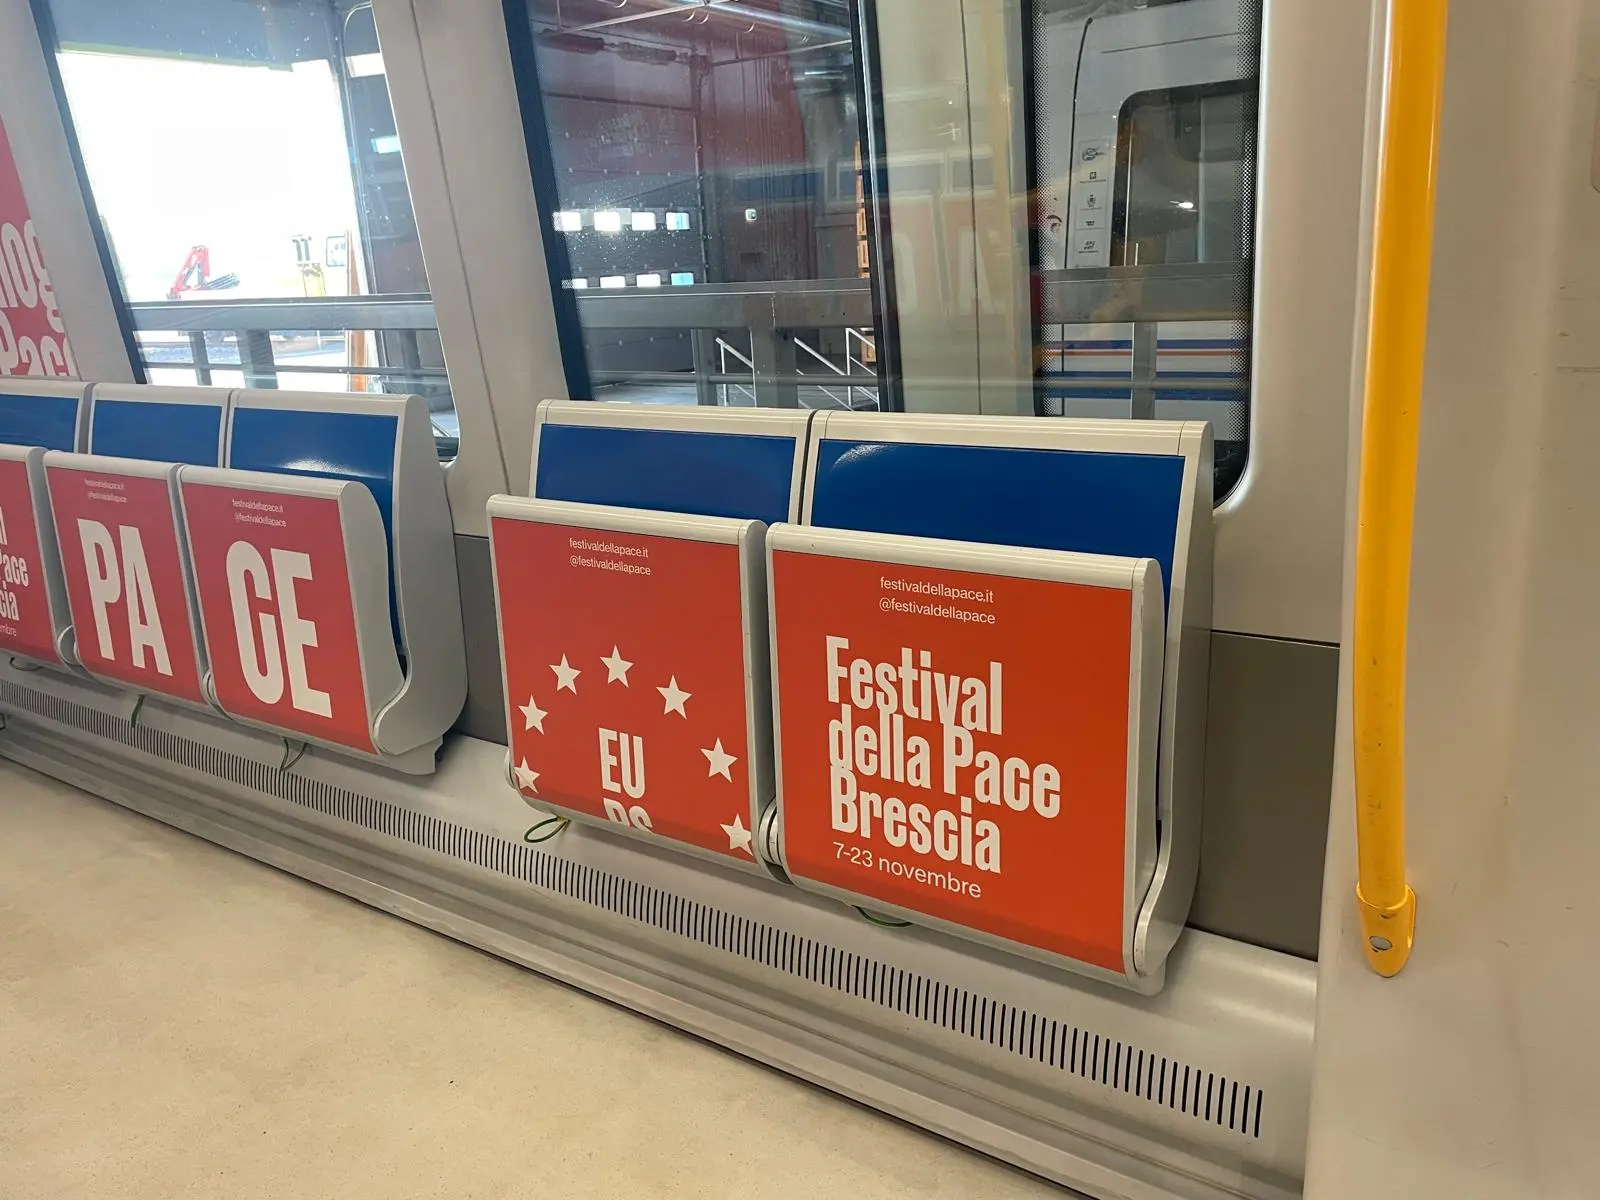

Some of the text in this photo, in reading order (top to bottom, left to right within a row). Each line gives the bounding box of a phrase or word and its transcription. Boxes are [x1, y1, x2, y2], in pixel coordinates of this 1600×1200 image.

[0, 549, 29, 587] ace
[569, 537, 649, 558] festivaldellapace.it
[569, 555, 651, 576] @festivaldellapace
[77, 518, 174, 677] PA
[879, 576, 994, 604] festivaldellapace.it
[879, 597, 996, 625] @festivaldellapace
[225, 540, 333, 719] CE
[825, 635, 1003, 736] Festival
[598, 727, 646, 799] EU
[828, 703, 1062, 819] della Pace
[830, 764, 1002, 874] Brescia
[832, 841, 982, 899] 7-23 novembre
